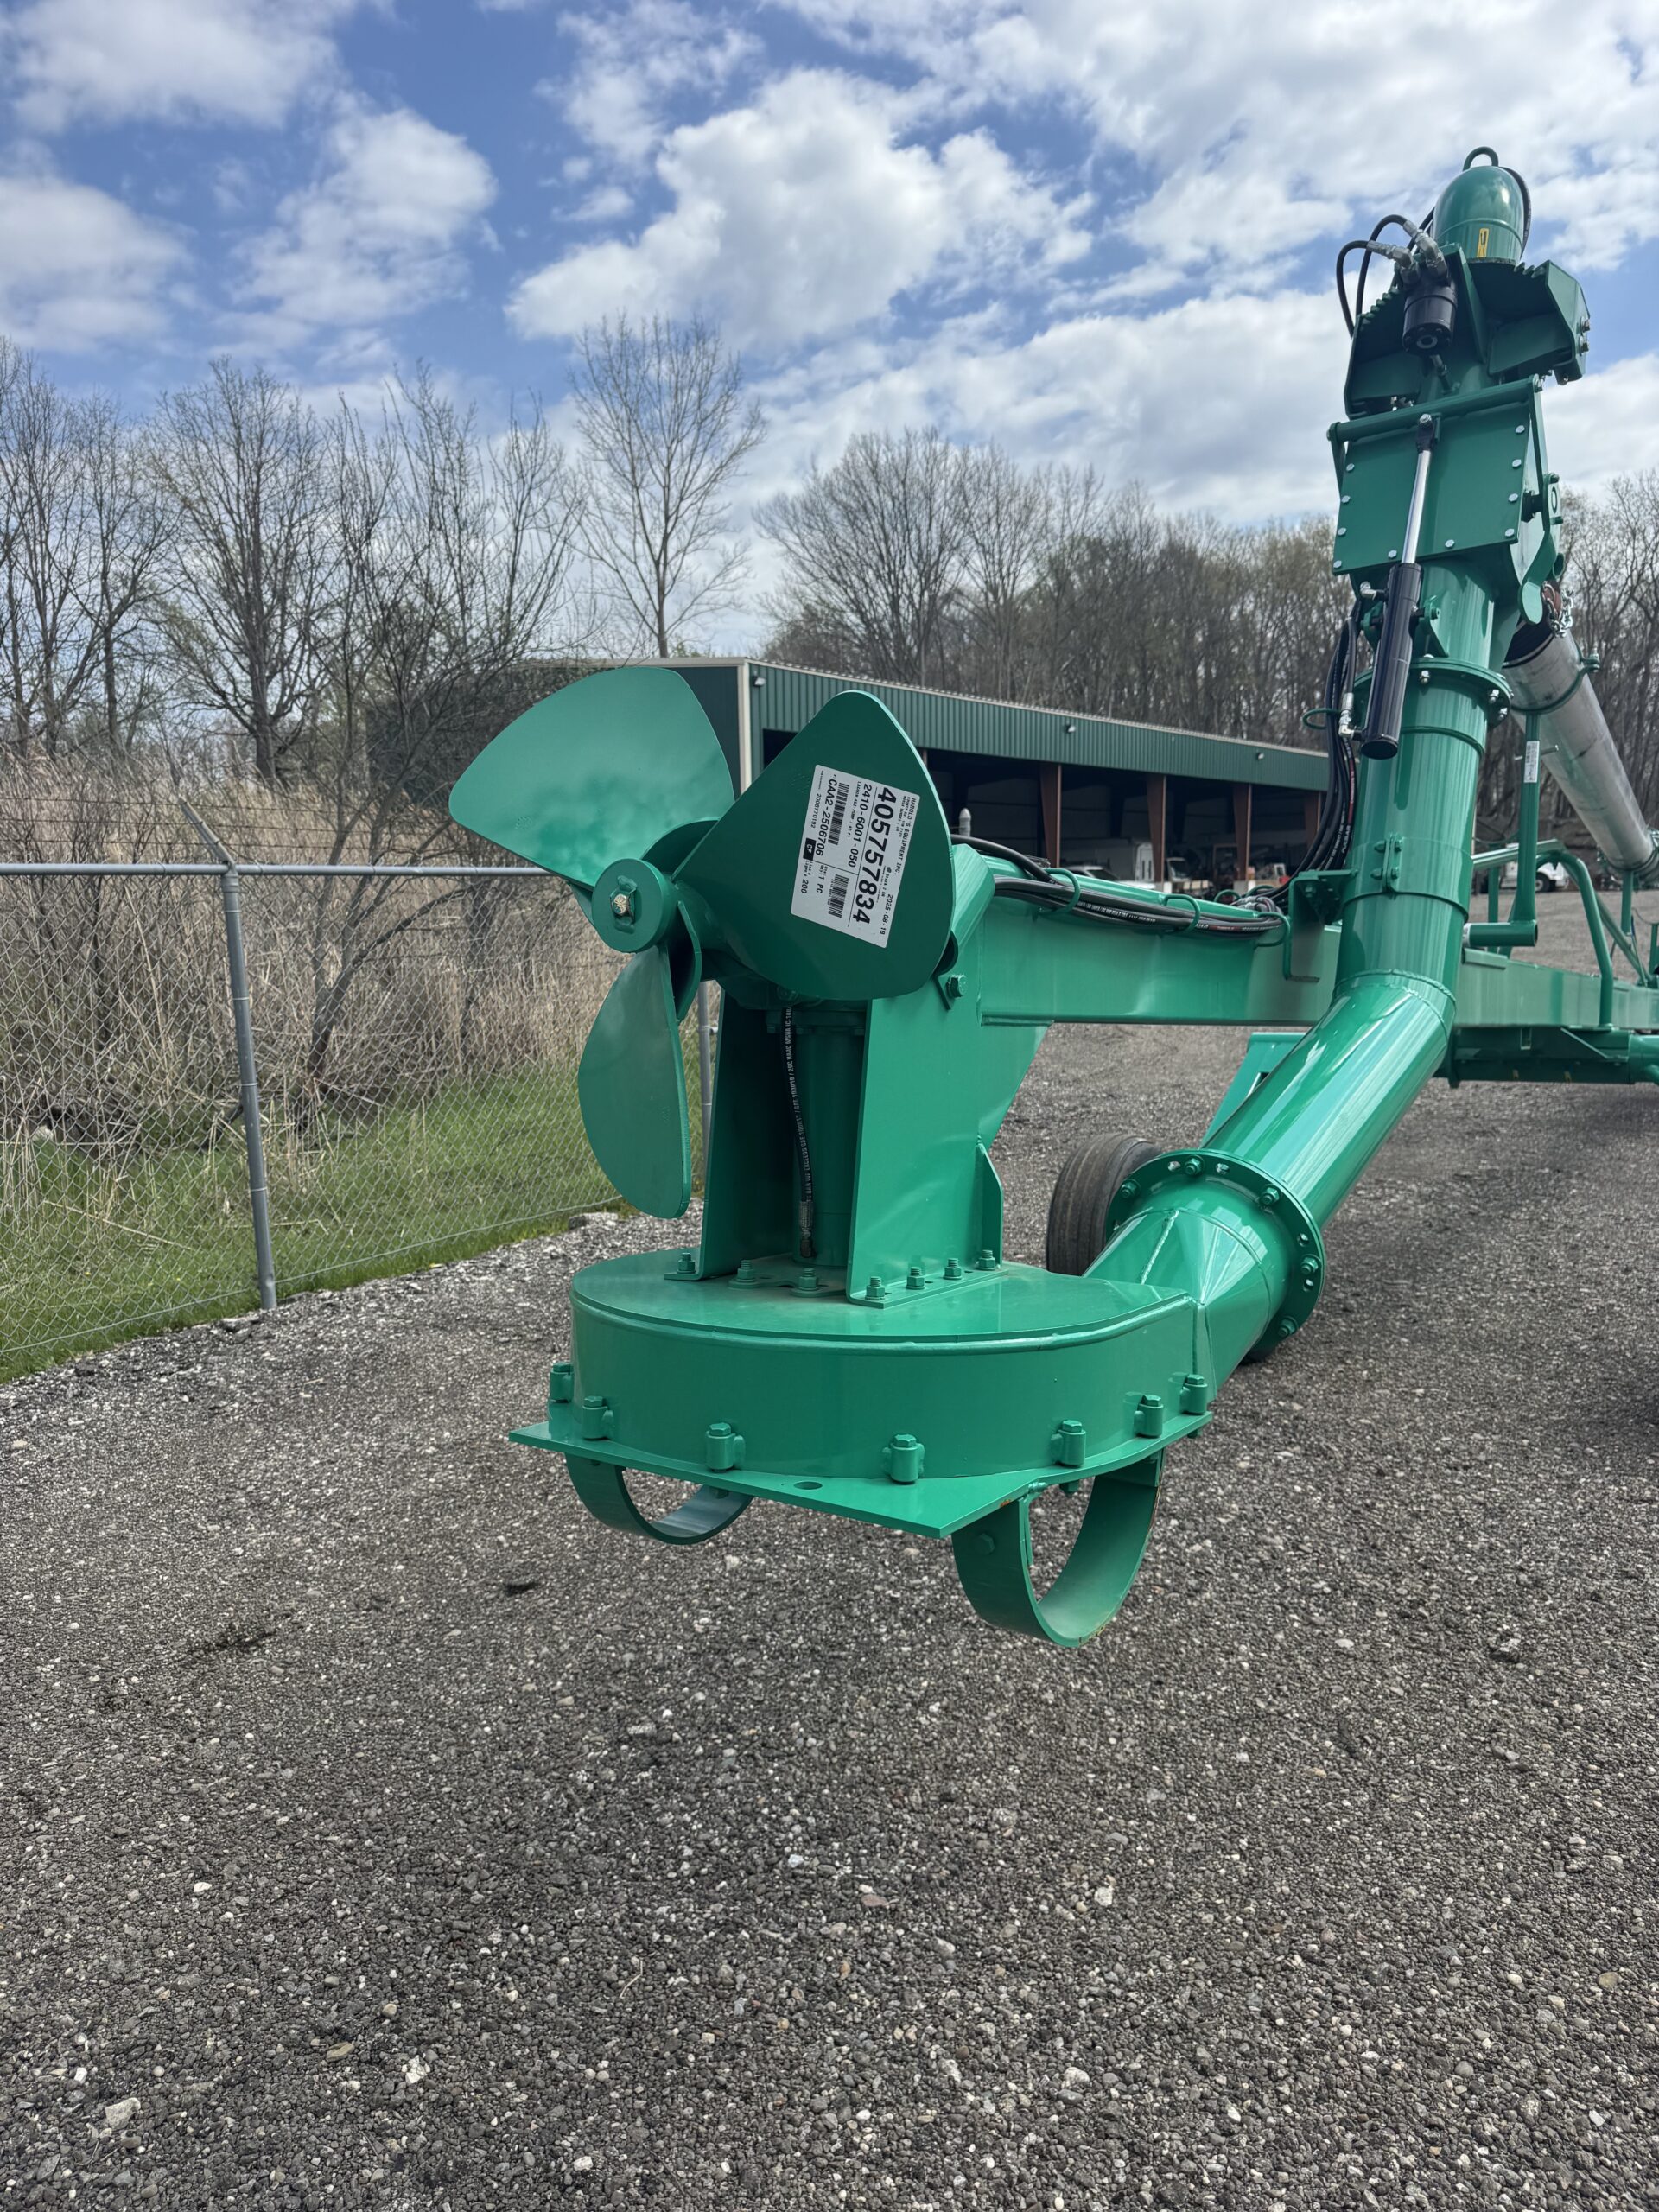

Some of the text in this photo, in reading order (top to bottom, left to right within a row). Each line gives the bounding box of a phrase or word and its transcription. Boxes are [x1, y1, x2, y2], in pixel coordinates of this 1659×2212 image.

[810, 792, 822, 829] 2008770192
[815, 777, 837, 857] CAA2-2506706
[847, 782, 873, 868] 2410-6001-050
[851, 785, 899, 926] 405757834
[897, 828, 910, 861] EQUIPMENT
[799, 878, 809, 894] 200
[893, 861, 902, 876] INC.
[815, 882, 824, 893] PC
[879, 893, 893, 936] 2025-08-18
